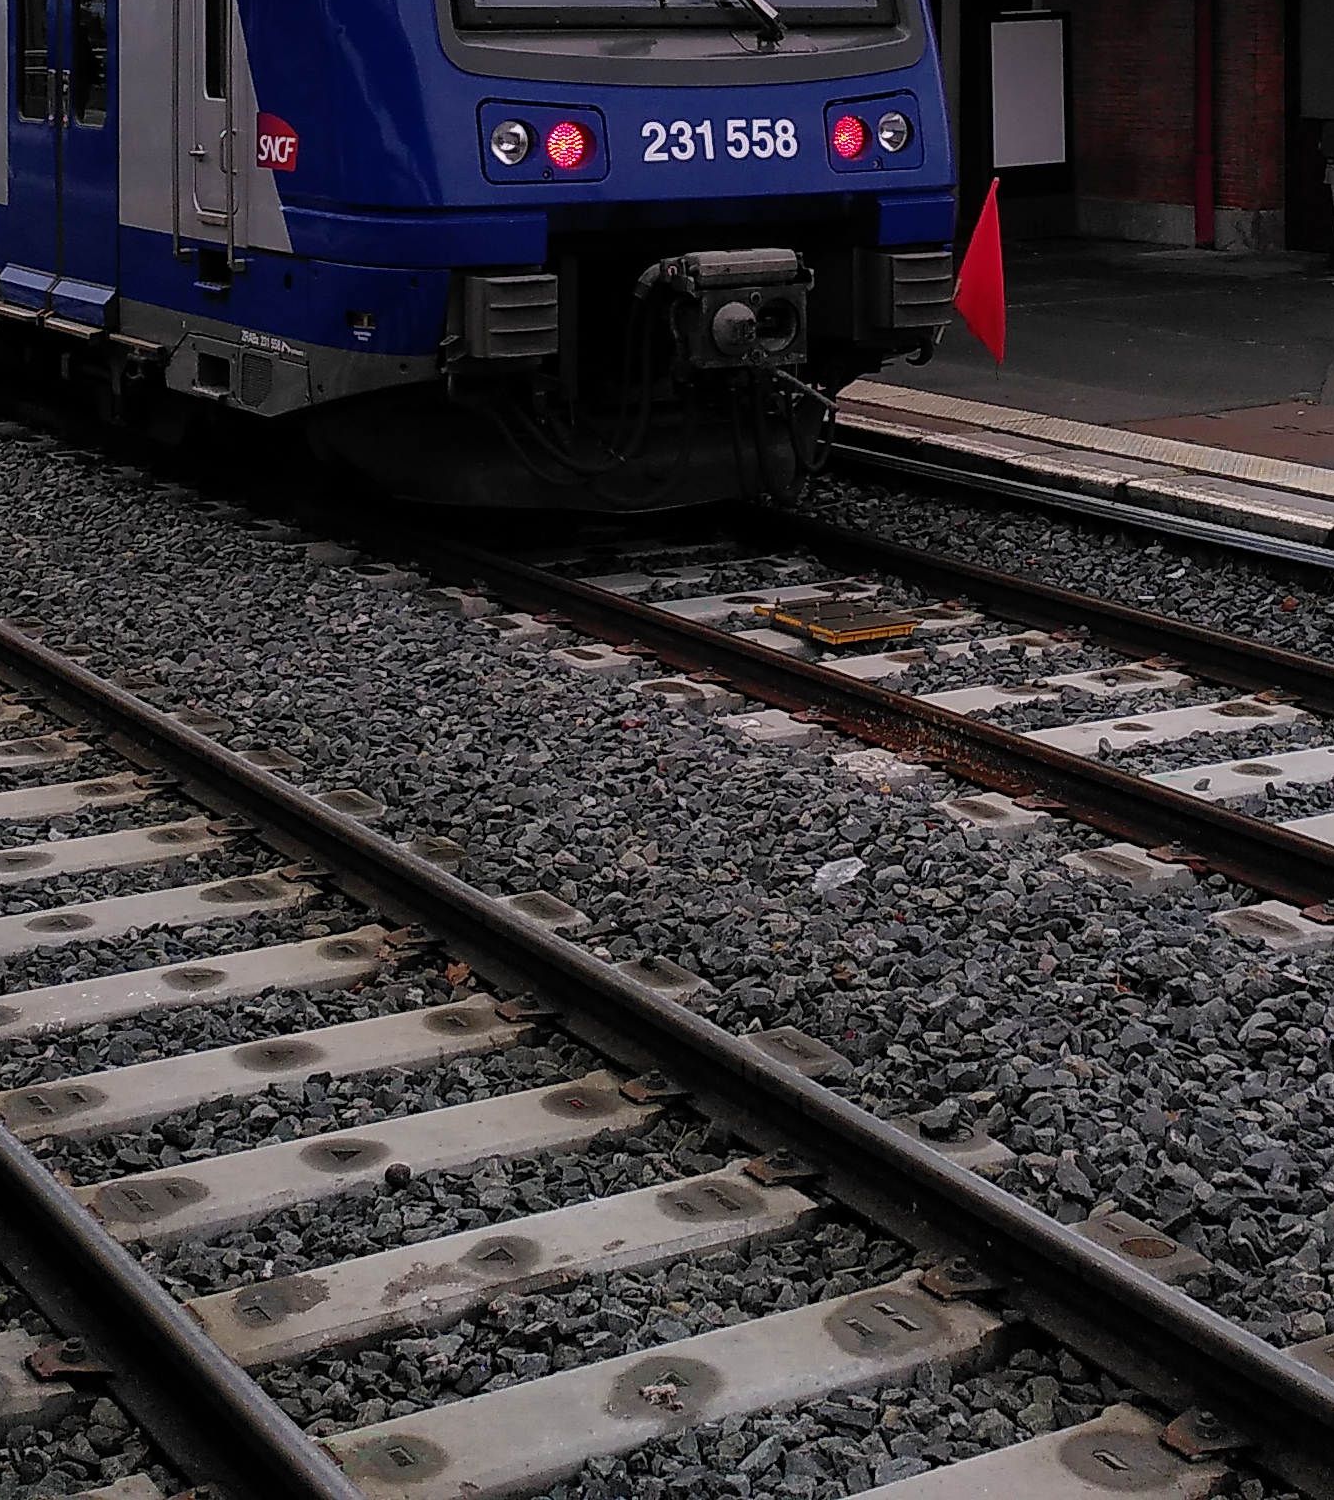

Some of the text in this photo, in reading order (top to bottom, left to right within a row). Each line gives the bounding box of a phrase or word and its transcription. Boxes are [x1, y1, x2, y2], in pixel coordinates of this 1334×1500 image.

[257, 134, 297, 163] SNCF
[641, 118, 798, 162] 231 558
